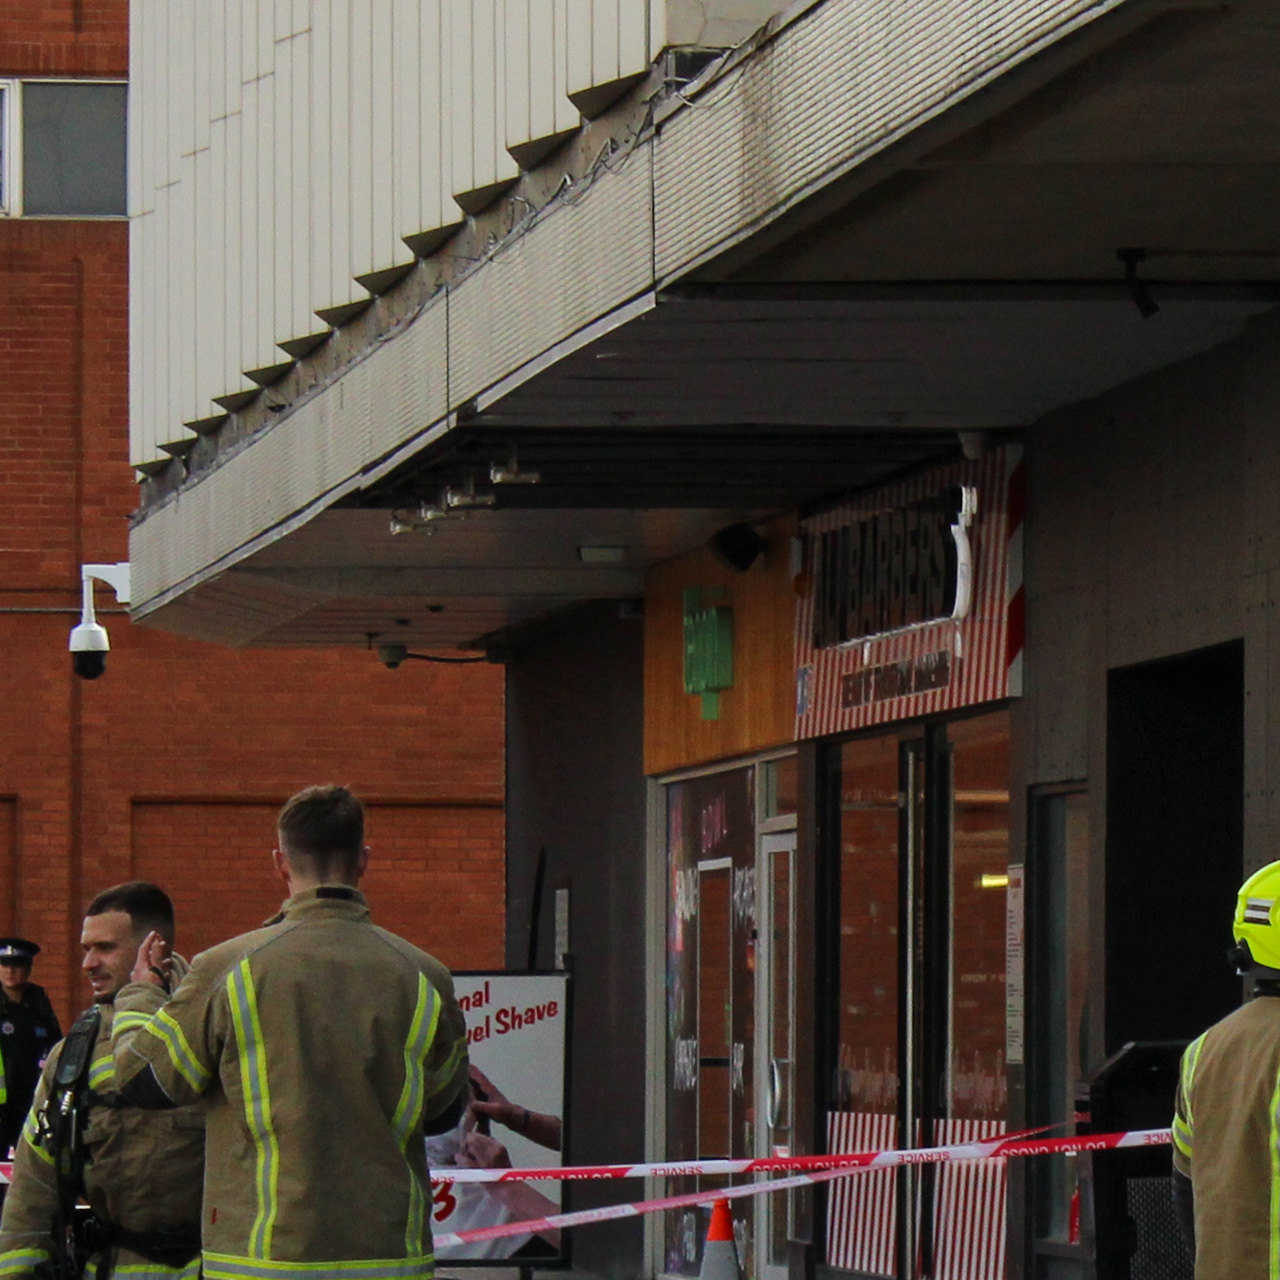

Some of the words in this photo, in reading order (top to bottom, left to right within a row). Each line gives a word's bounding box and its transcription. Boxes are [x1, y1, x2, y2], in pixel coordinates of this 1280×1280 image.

[494, 1000, 559, 1034] Shave
[897, 1150, 951, 1164] SERVICE
[649, 1165, 704, 1178] SERVICE
